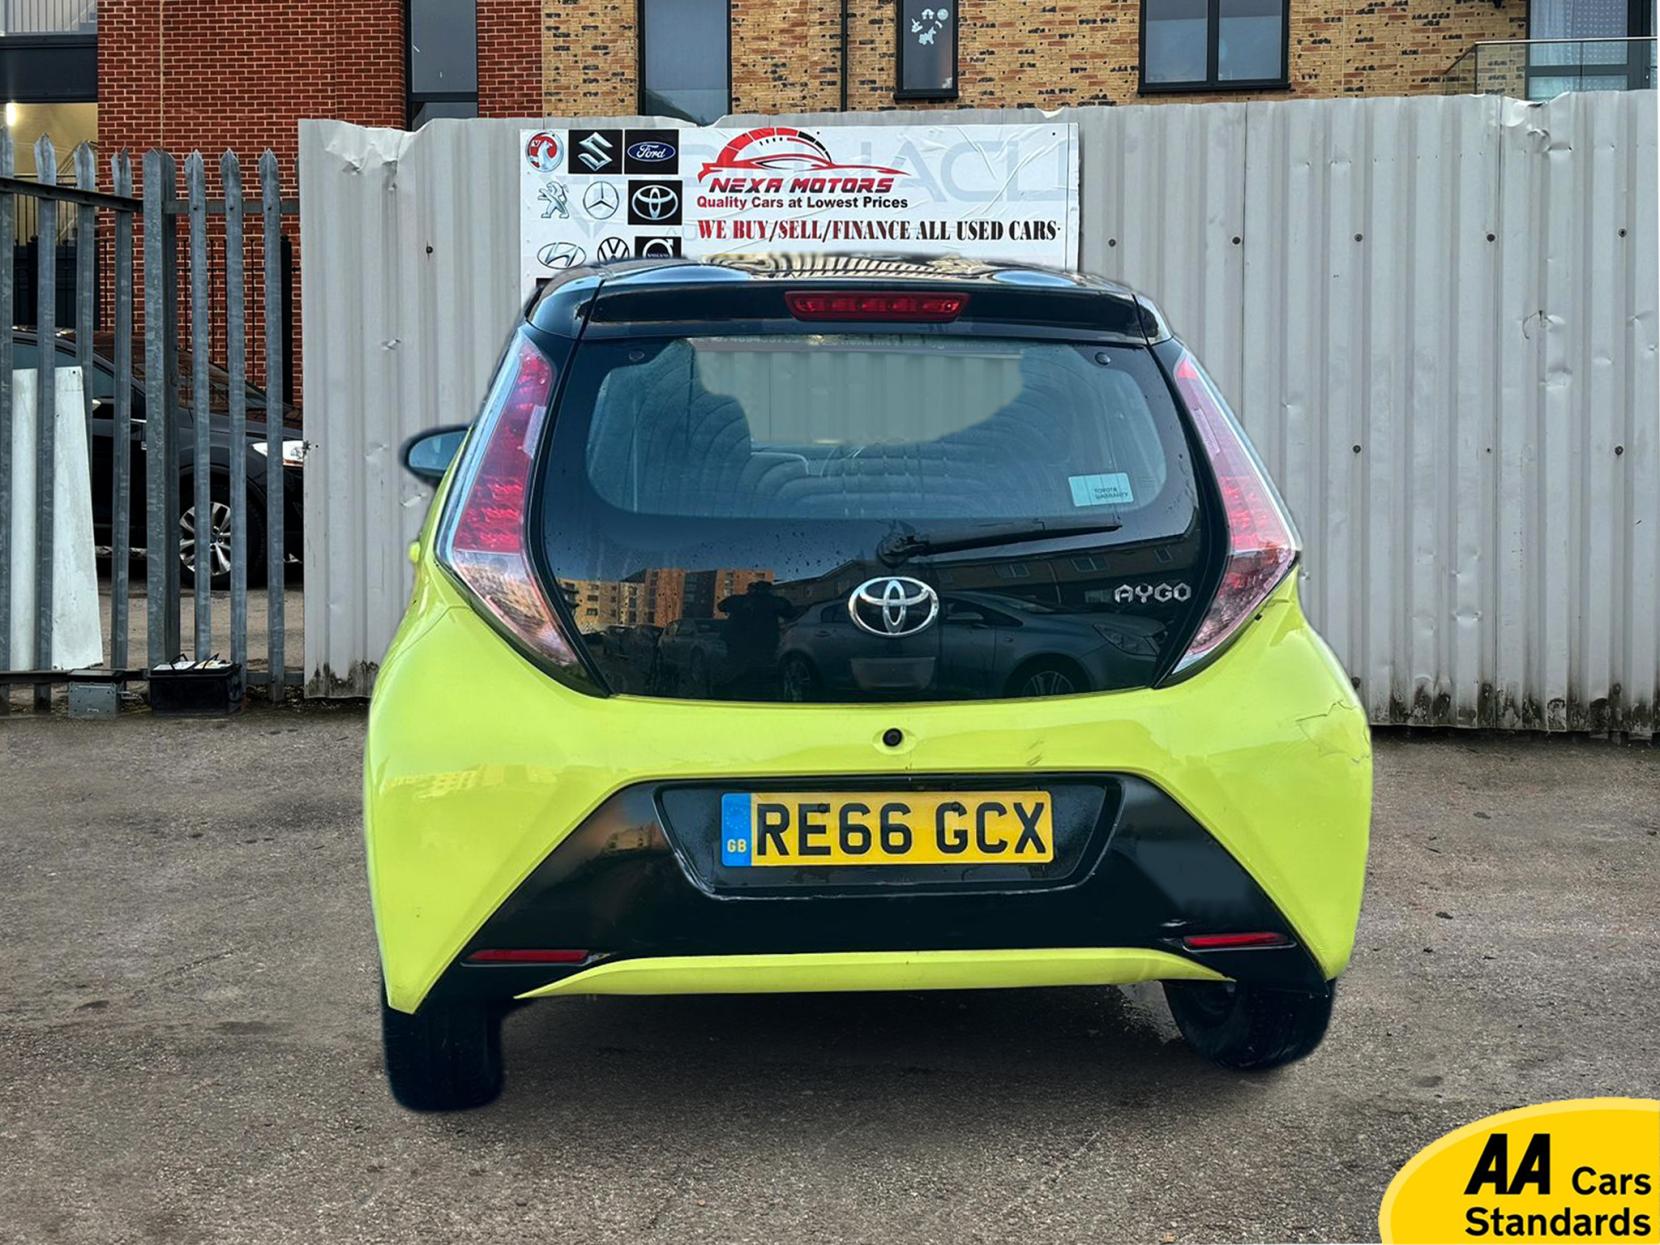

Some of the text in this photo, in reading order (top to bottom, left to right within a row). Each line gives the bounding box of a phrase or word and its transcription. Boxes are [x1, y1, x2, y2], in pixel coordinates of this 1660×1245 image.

[636, 144, 667, 158] Ford
[708, 177, 895, 193] NEXA MOTORS
[696, 196, 908, 210] Quality Cars at Lowest Prices
[697, 219, 727, 240] WE
[915, 220, 951, 240] ALL
[956, 220, 1004, 241] USED
[1114, 582, 1192, 603] AYGO
[756, 800, 1048, 857] RE66 GCX
[726, 838, 747, 853] GB
